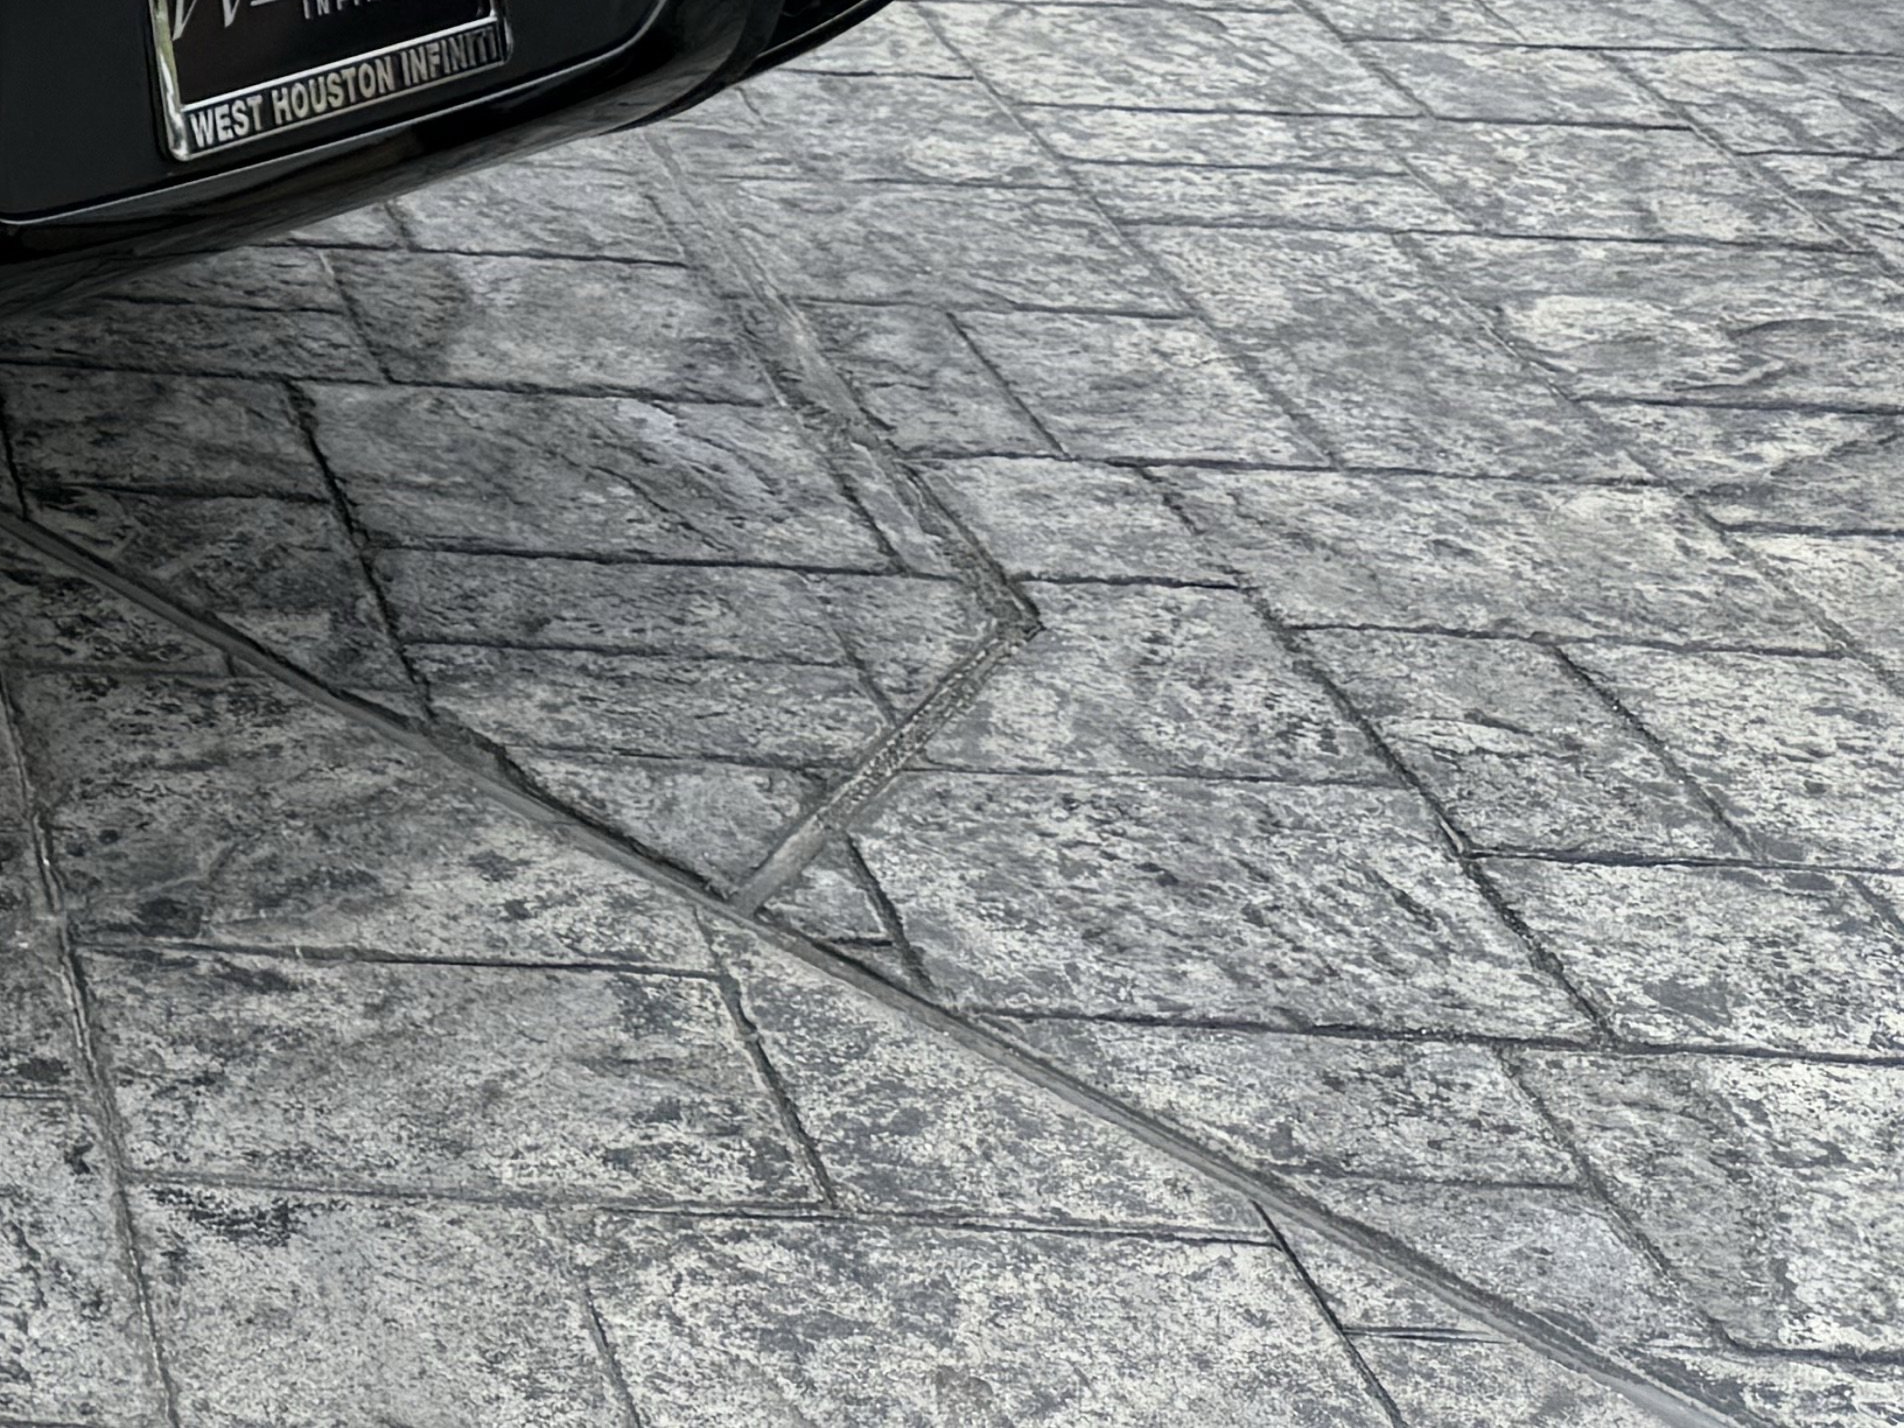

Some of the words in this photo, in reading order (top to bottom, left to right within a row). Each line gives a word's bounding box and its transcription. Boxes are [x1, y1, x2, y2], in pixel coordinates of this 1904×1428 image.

[191, 93, 264, 149] WEST
[271, 63, 392, 127] HOUSTON
[400, 28, 500, 88] INFINITI
